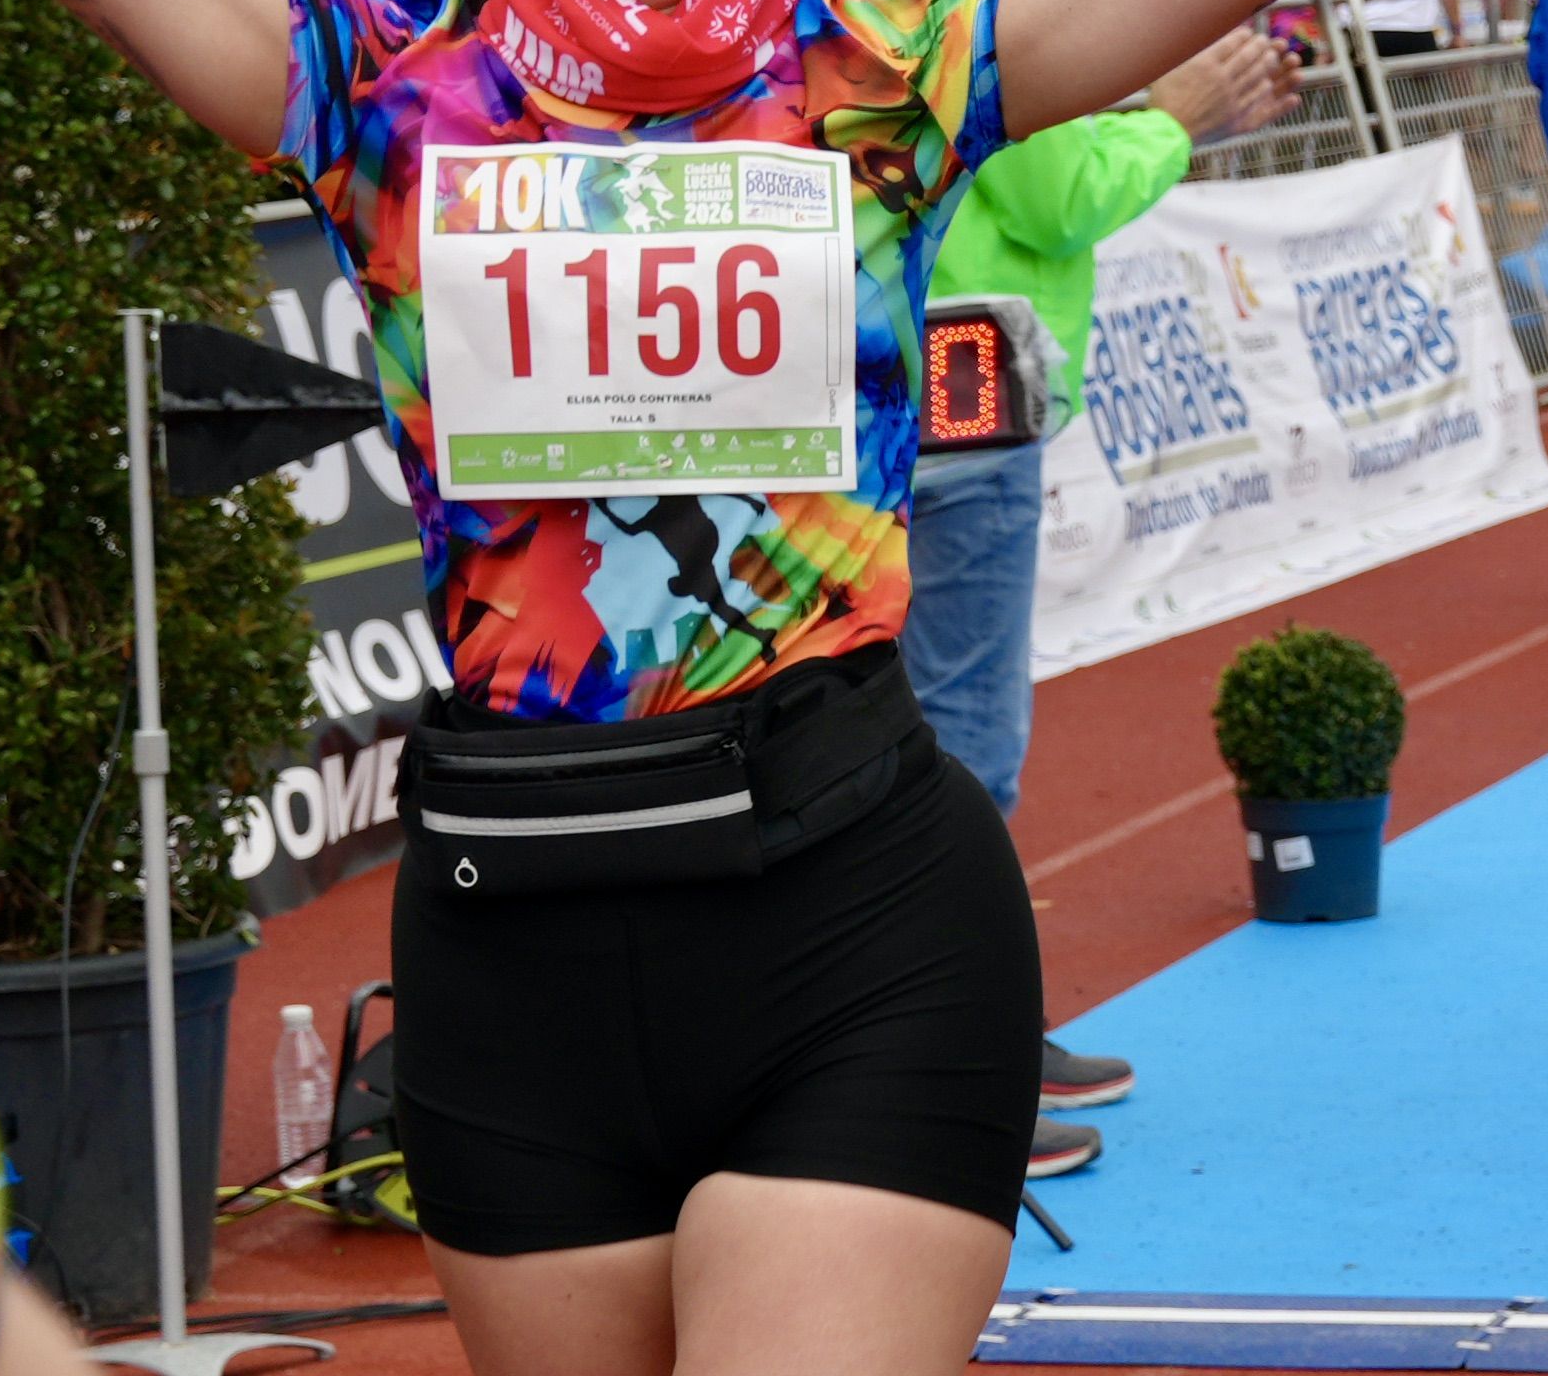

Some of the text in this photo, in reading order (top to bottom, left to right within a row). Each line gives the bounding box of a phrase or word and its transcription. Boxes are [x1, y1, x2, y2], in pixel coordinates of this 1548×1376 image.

[745, 179, 827, 200] populares
[746, 169, 813, 190] carreras
[464, 158, 587, 231] 10K
[684, 202, 734, 225] 2026
[484, 243, 782, 379] 1156
[566, 393, 713, 405] ELISA POLO CONTRERAS
[610, 415, 644, 424] TALLA
